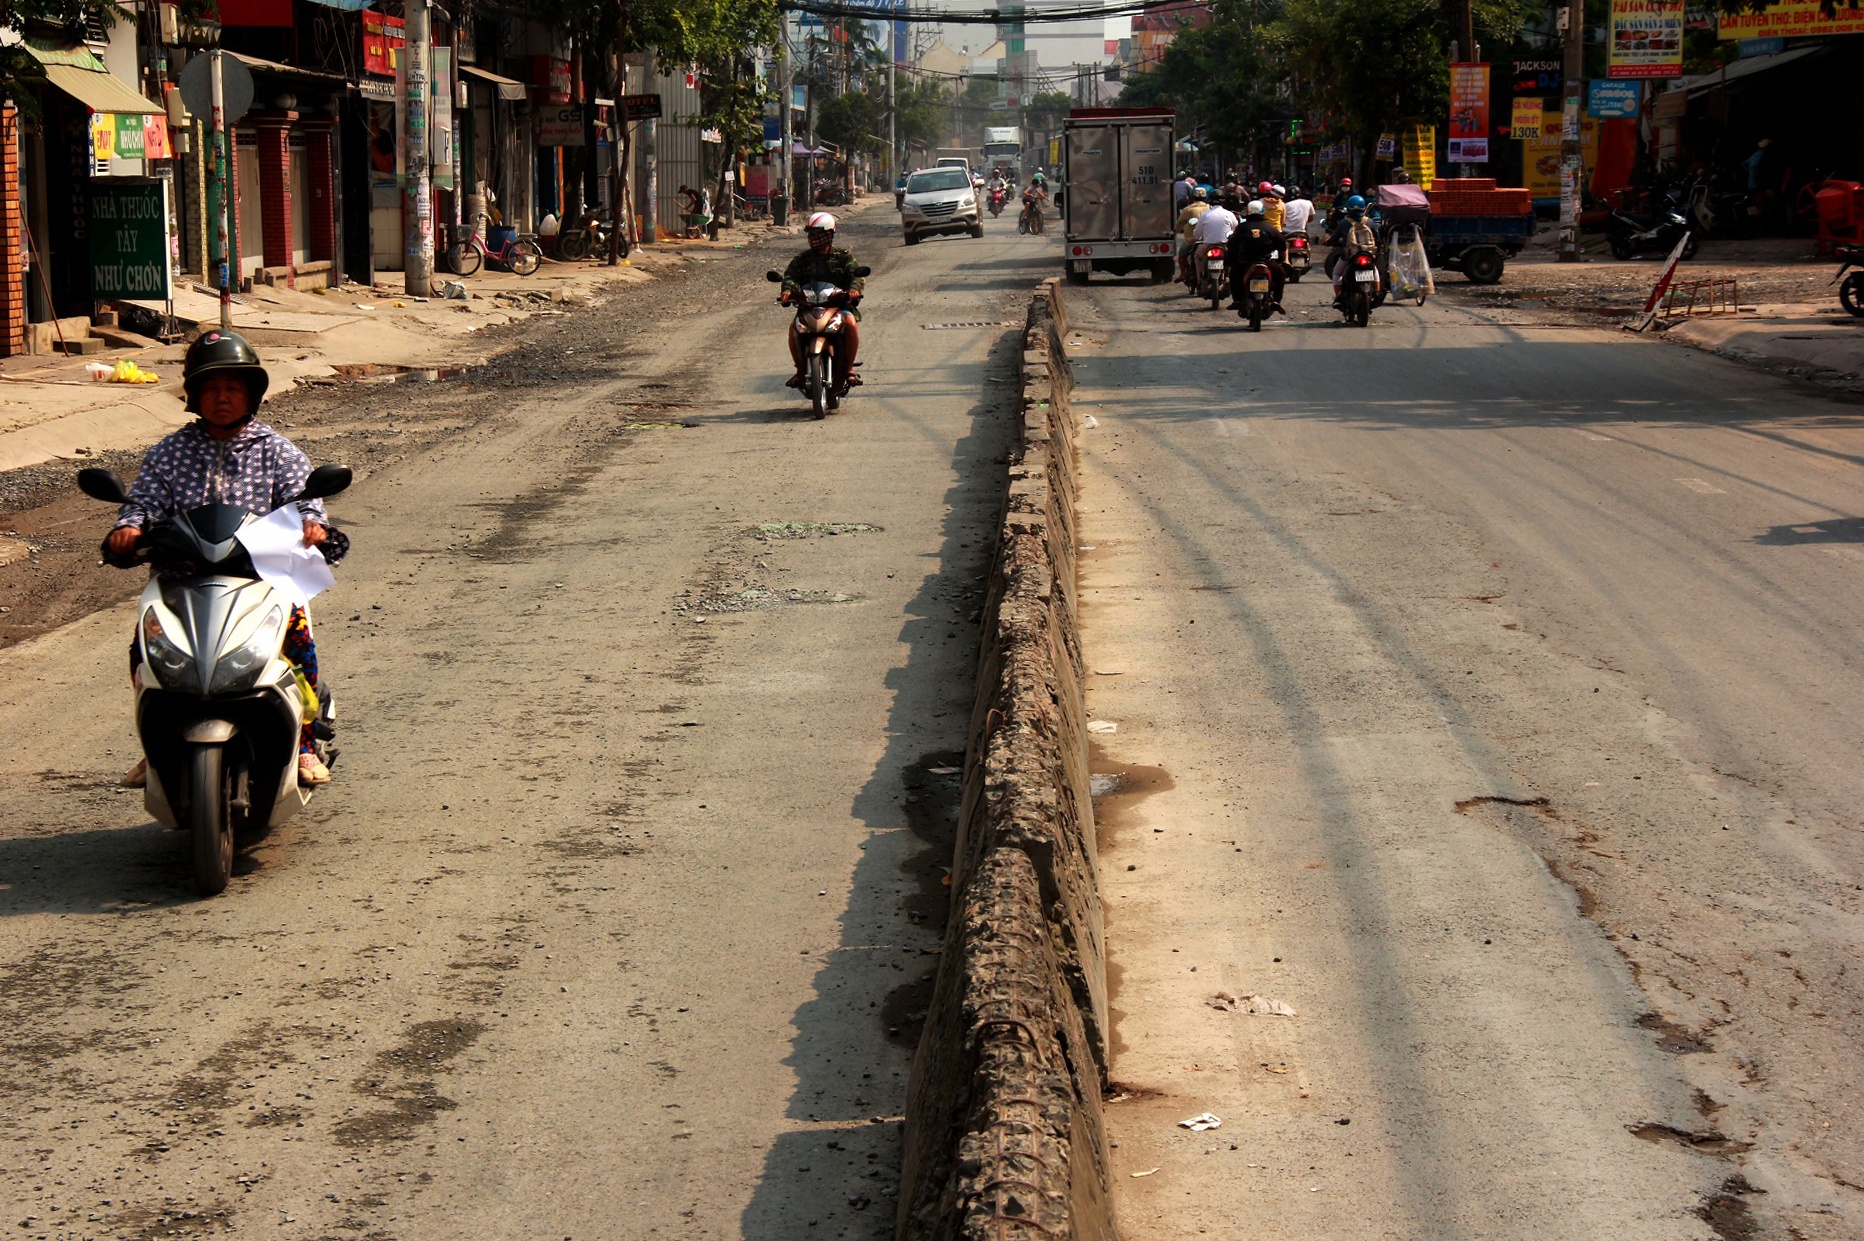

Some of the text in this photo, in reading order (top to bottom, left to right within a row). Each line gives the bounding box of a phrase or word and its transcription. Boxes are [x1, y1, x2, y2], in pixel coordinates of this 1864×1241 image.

[1512, 60, 1560, 76] JACKSON
[1538, 72, 1561, 89] DJ
[1511, 127, 1540, 139] 130K
[1138, 166, 1154, 175] 51D
[1132, 176, 1158, 185] 411.91
[92, 186, 159, 219] NHÀ THUỐC
[116, 224, 138, 253] TÂY
[95, 260, 162, 293] NHƯ CHƠN
